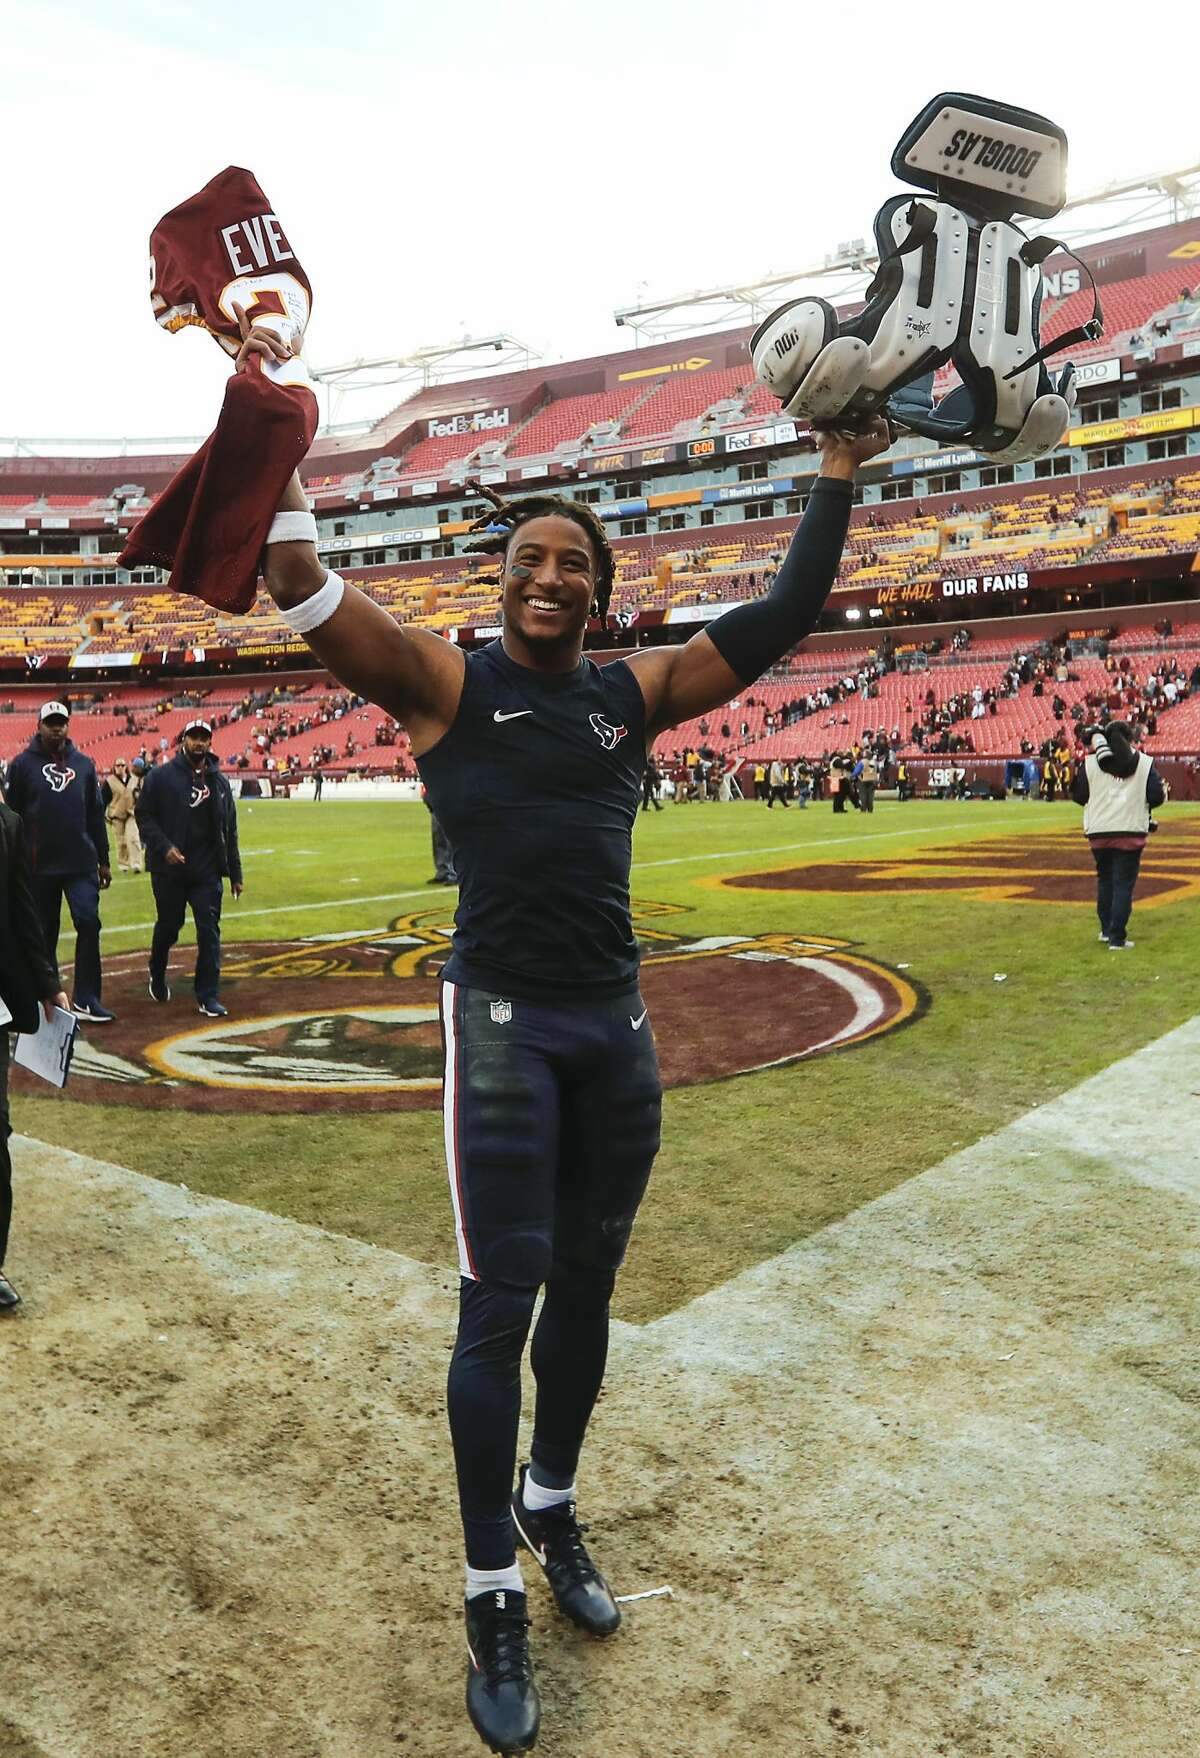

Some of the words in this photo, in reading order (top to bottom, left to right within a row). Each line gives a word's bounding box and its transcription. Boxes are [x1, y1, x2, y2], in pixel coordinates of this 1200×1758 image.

[943, 129, 1042, 179] DOUGLAS
[728, 432, 767, 450] FedEx
[925, 454, 951, 468] Merrill
[952, 450, 976, 465] Lynch
[729, 486, 752, 498] Merrill
[753, 483, 774, 495] Lynch
[382, 531, 423, 543] GEICO
[877, 587, 898, 603] WE
[901, 582, 935, 600] HAIL
[942, 577, 977, 596] OUR
[983, 572, 1028, 592] FANS
[237, 645, 285, 656] WASHINGTON
